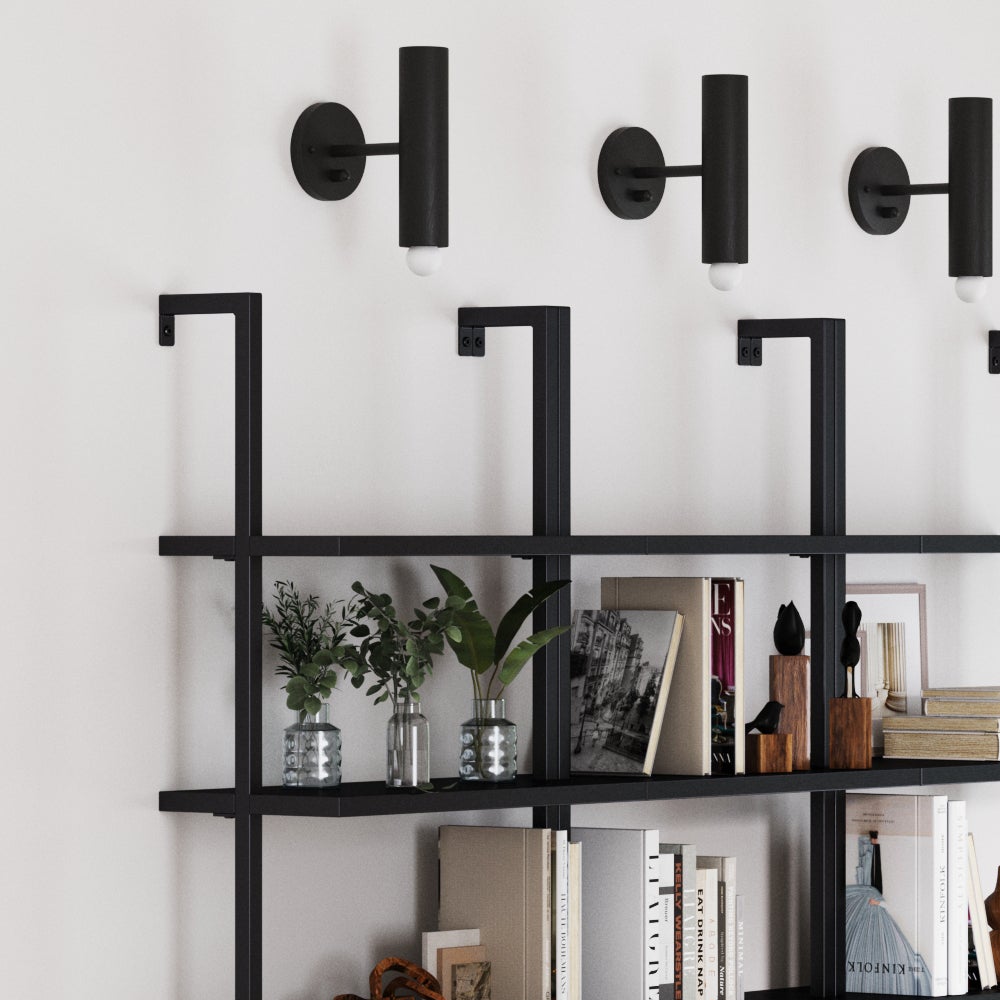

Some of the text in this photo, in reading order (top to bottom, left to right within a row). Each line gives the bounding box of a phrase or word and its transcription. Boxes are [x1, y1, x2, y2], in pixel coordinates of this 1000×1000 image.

[682, 888, 695, 977] LIAIGRE
[737, 921, 745, 977] MINIMAL
[718, 965, 726, 996] Nature
[847, 961, 906, 975] KINFOLK
